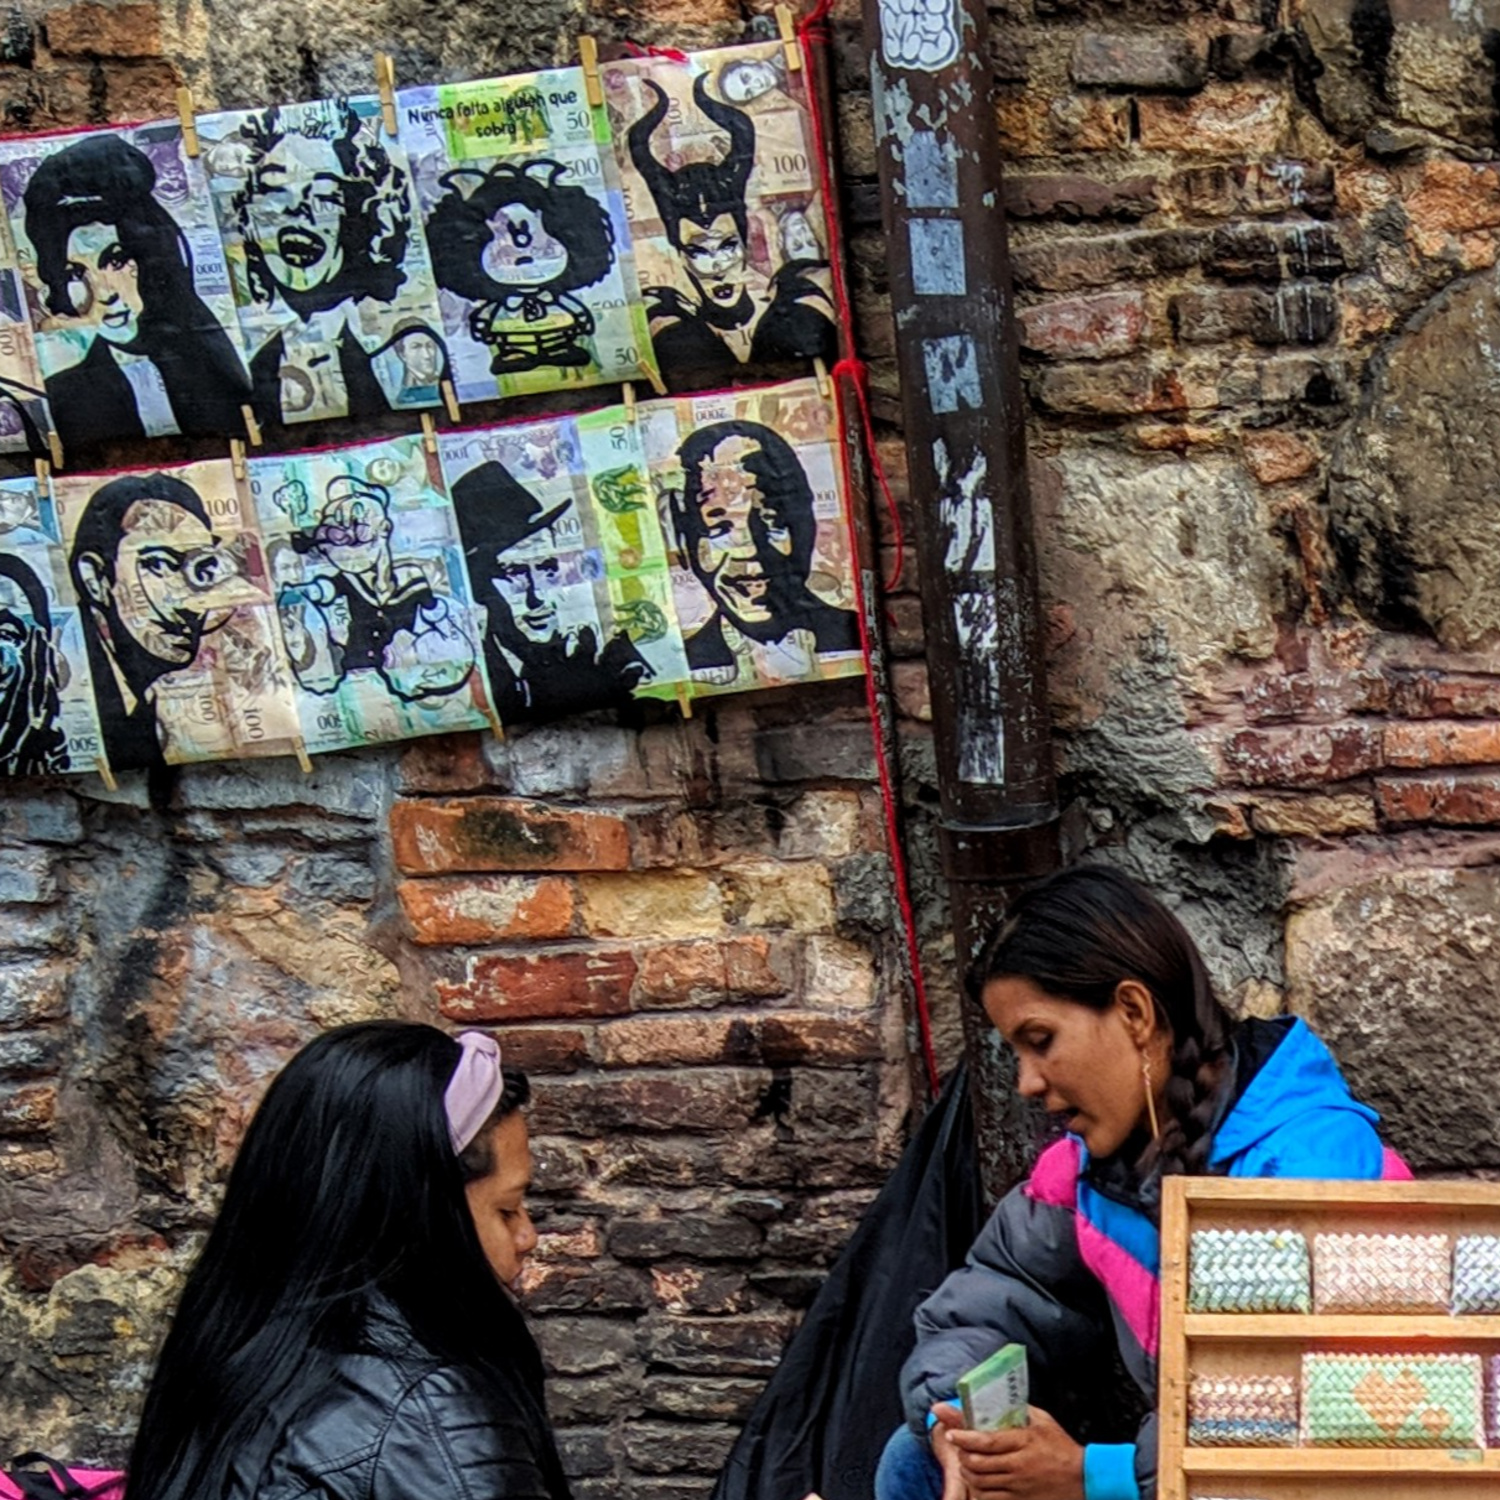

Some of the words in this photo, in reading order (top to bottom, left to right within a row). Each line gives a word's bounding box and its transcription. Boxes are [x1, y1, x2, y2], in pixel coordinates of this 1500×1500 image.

[549, 89, 577, 107] que
[567, 110, 590, 129] 50
[773, 153, 806, 174] 100
[615, 346, 638, 366] 50
[207, 499, 239, 516] 100
[245, 707, 264, 740] 100
